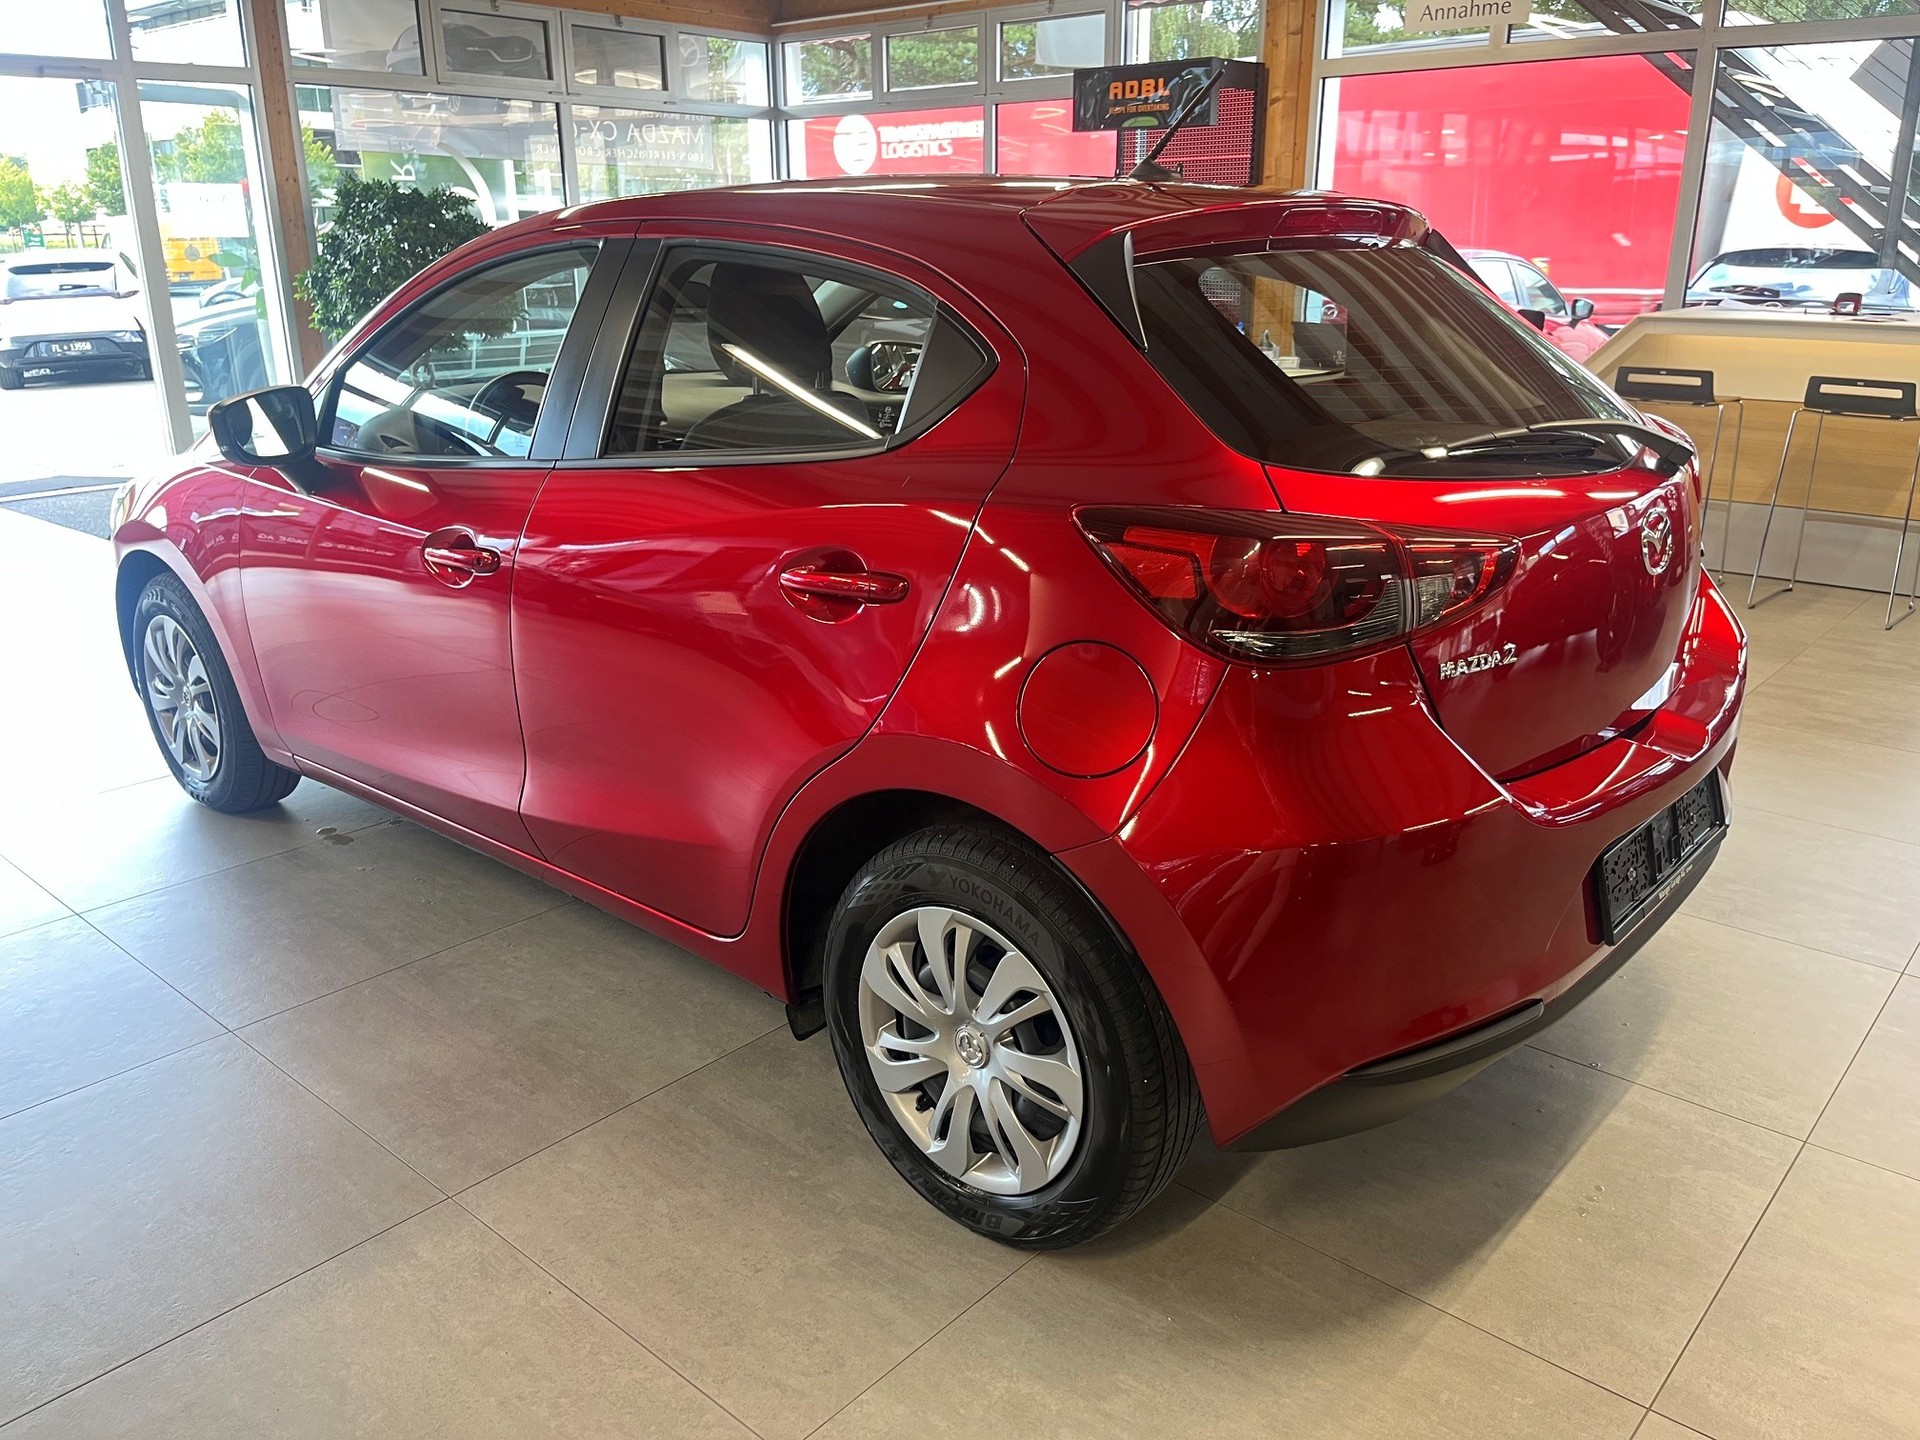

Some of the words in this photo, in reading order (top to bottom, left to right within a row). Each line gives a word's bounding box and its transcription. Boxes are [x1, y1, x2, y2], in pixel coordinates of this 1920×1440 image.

[1419, 0, 1512, 22] Annahme
[1109, 78, 1170, 100] ADBL
[878, 120, 984, 142] TRANSPARTNE
[881, 139, 954, 159] LOGISTICS
[51, 343, 62, 353] FL
[949, 873, 1041, 948] YOKOHAMA
